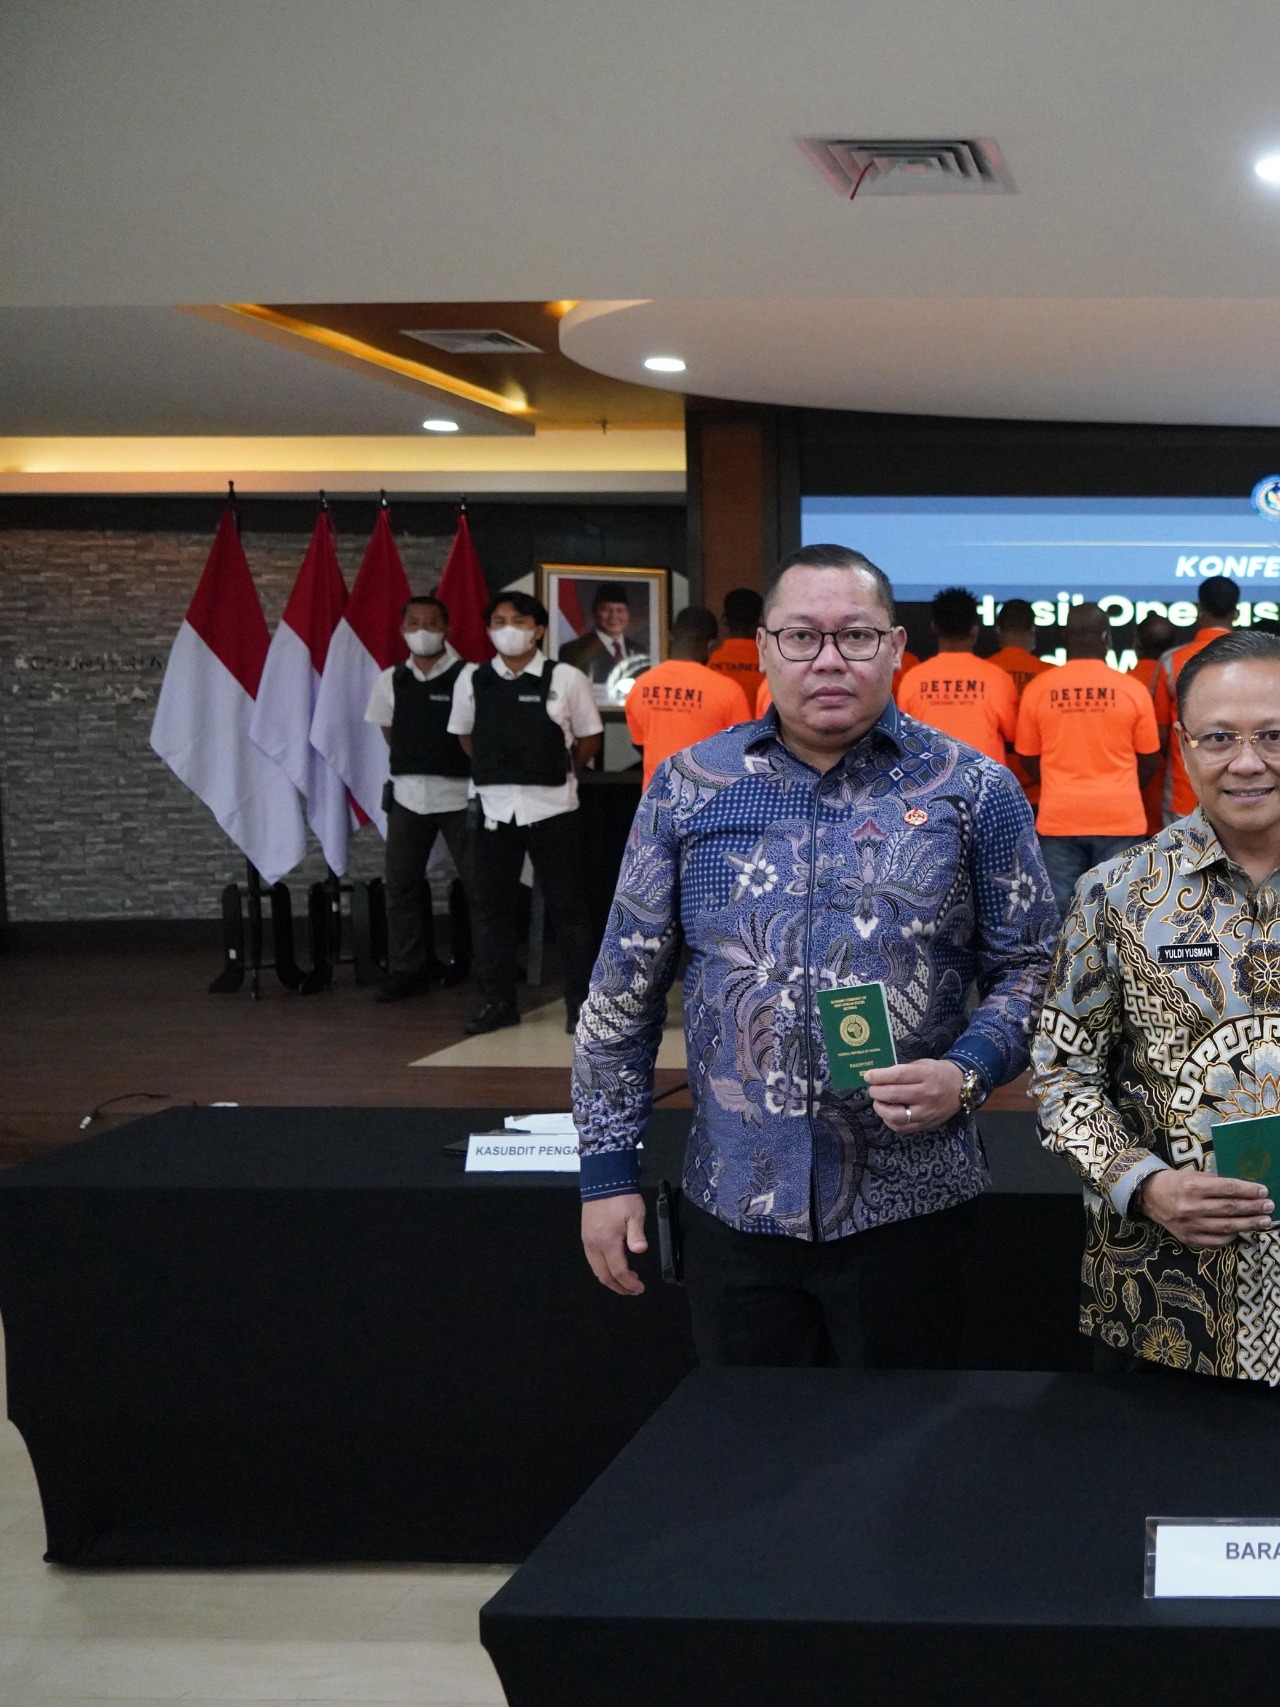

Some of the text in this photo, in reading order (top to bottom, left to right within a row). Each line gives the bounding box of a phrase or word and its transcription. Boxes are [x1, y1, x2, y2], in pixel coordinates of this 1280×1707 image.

[976, 591, 1083, 627] Hsi
[920, 680, 985, 693] DETENI
[642, 686, 702, 703] DETENI
[1050, 687, 1115, 702] DETENI
[1164, 947, 1213, 960] YULDI YUSMAN
[475, 1146, 536, 1156] KASUBDIT
